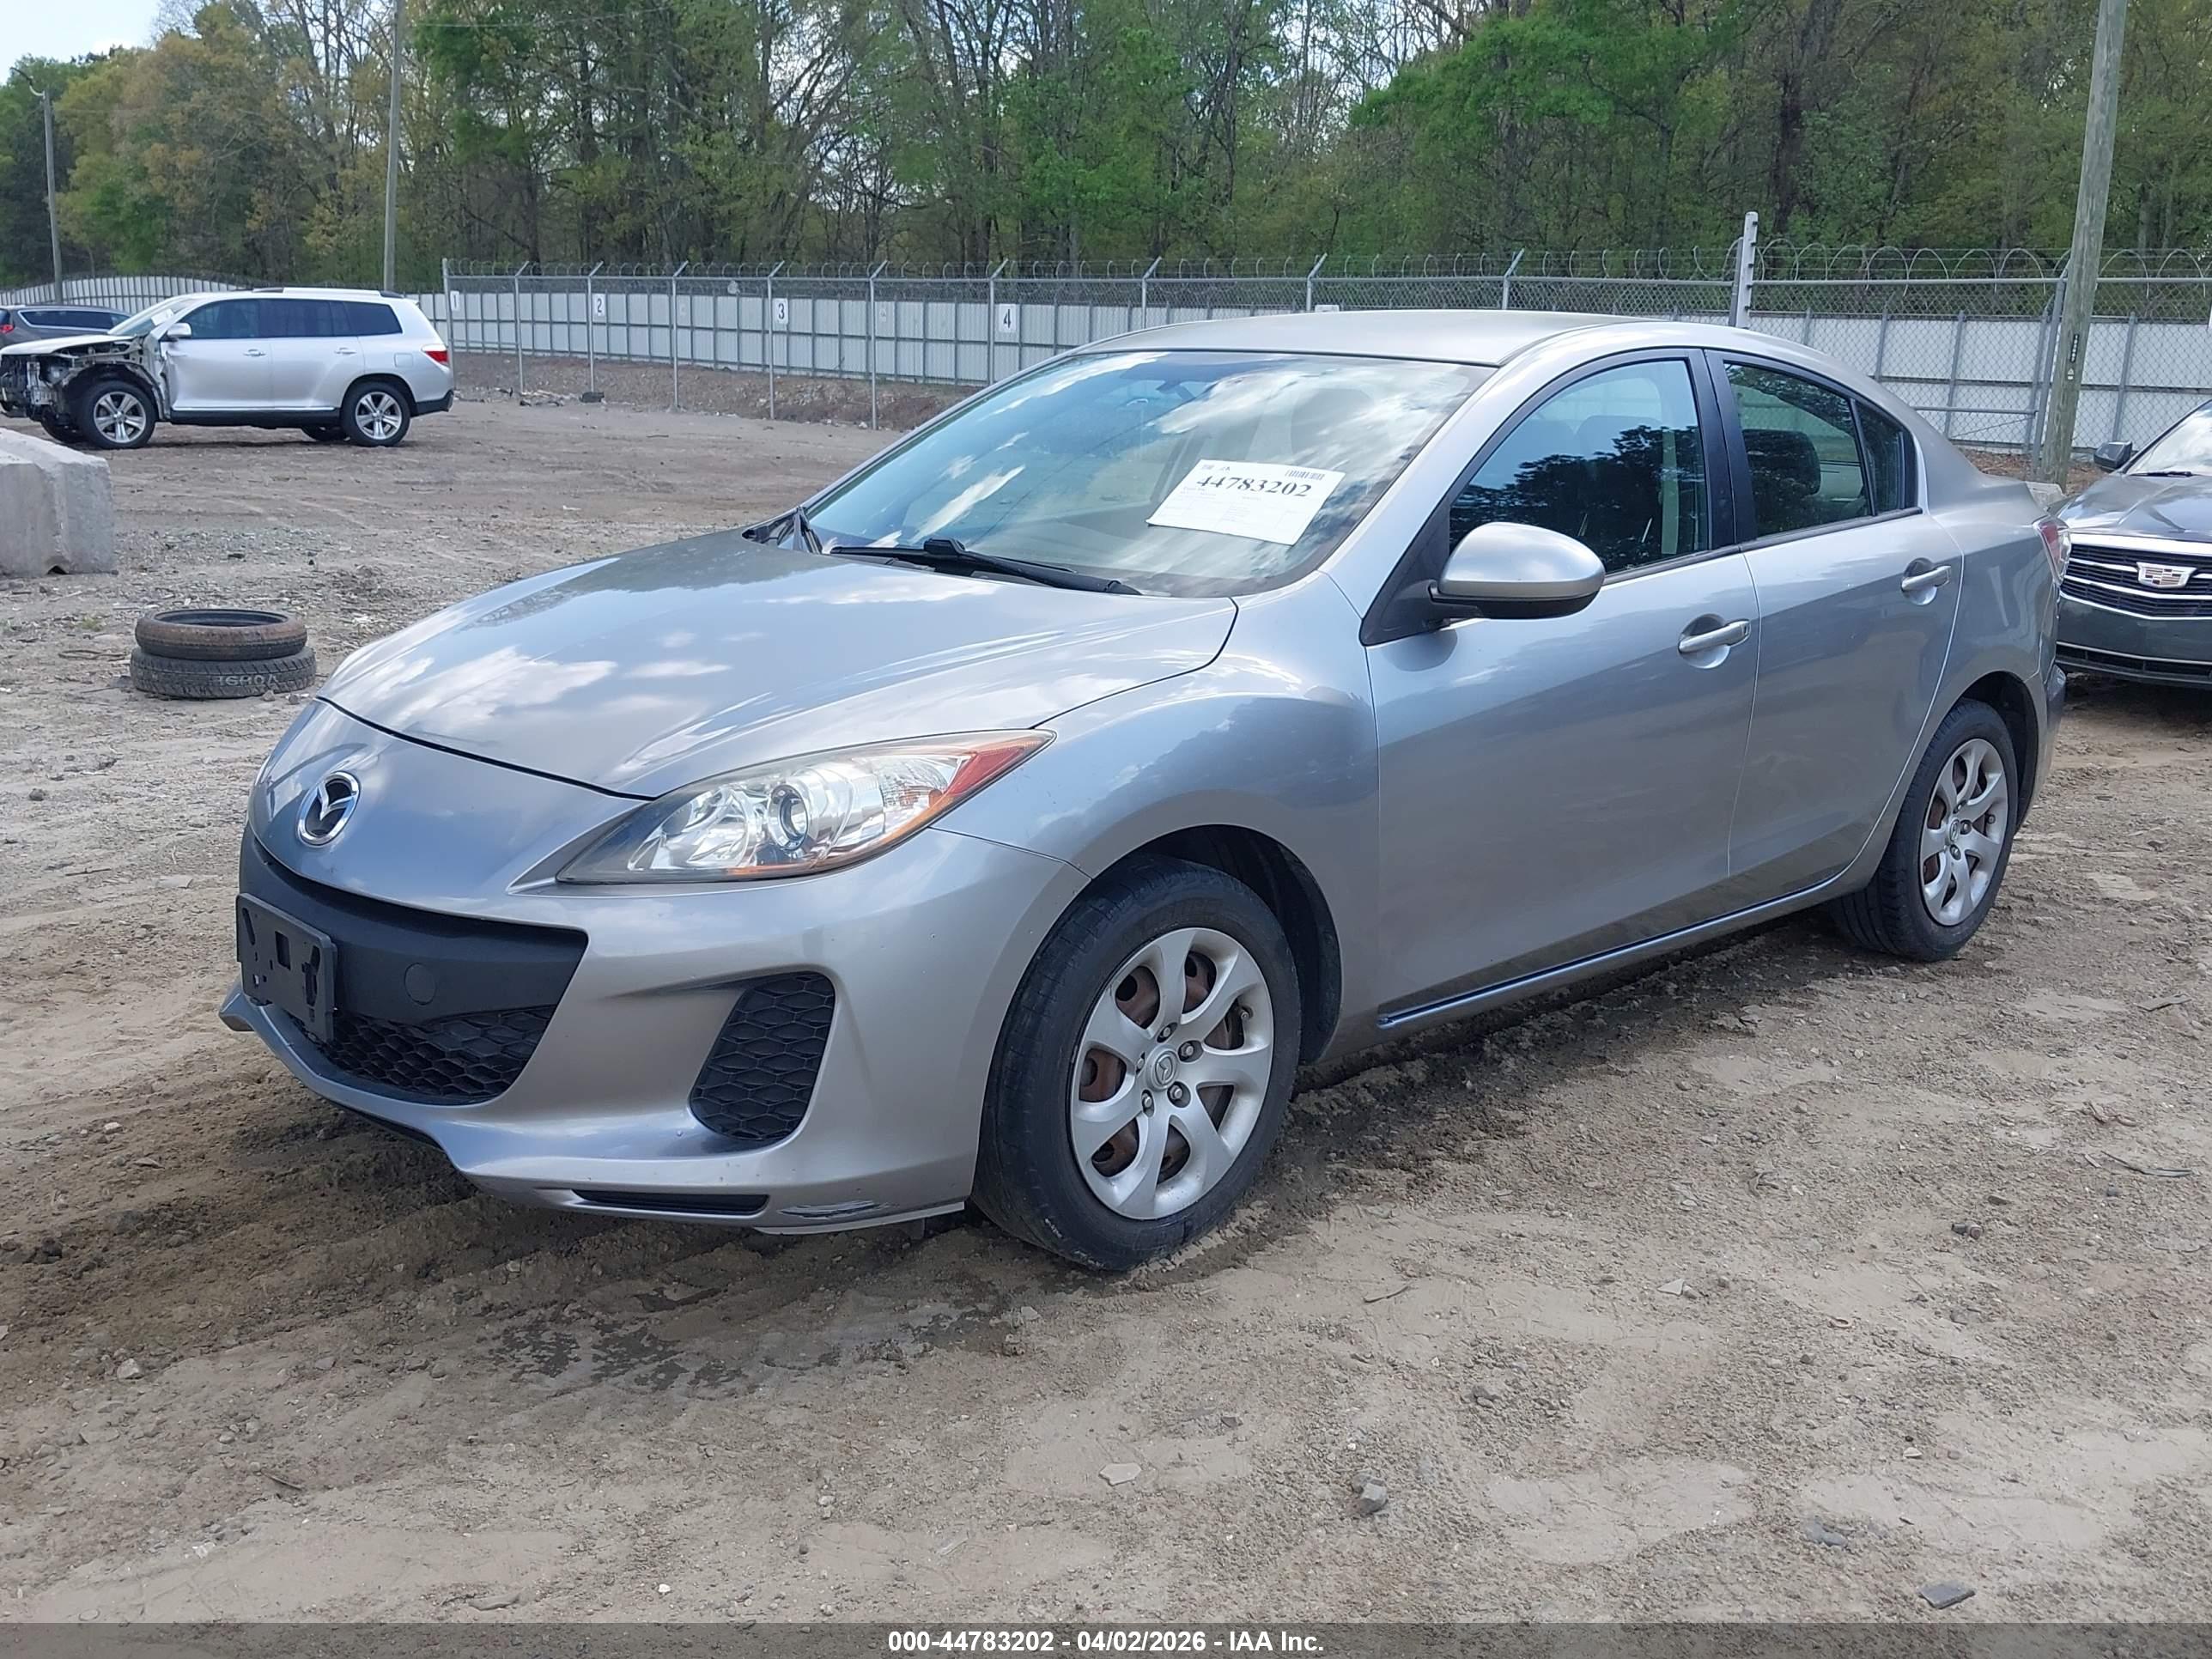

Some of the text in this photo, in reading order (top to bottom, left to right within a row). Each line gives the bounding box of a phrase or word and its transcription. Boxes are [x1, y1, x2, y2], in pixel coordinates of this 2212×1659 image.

[597, 297, 603, 313] 2
[778, 302, 785, 319] 3
[1003, 308, 1012, 328] 4
[1196, 476, 1312, 496] 44783202
